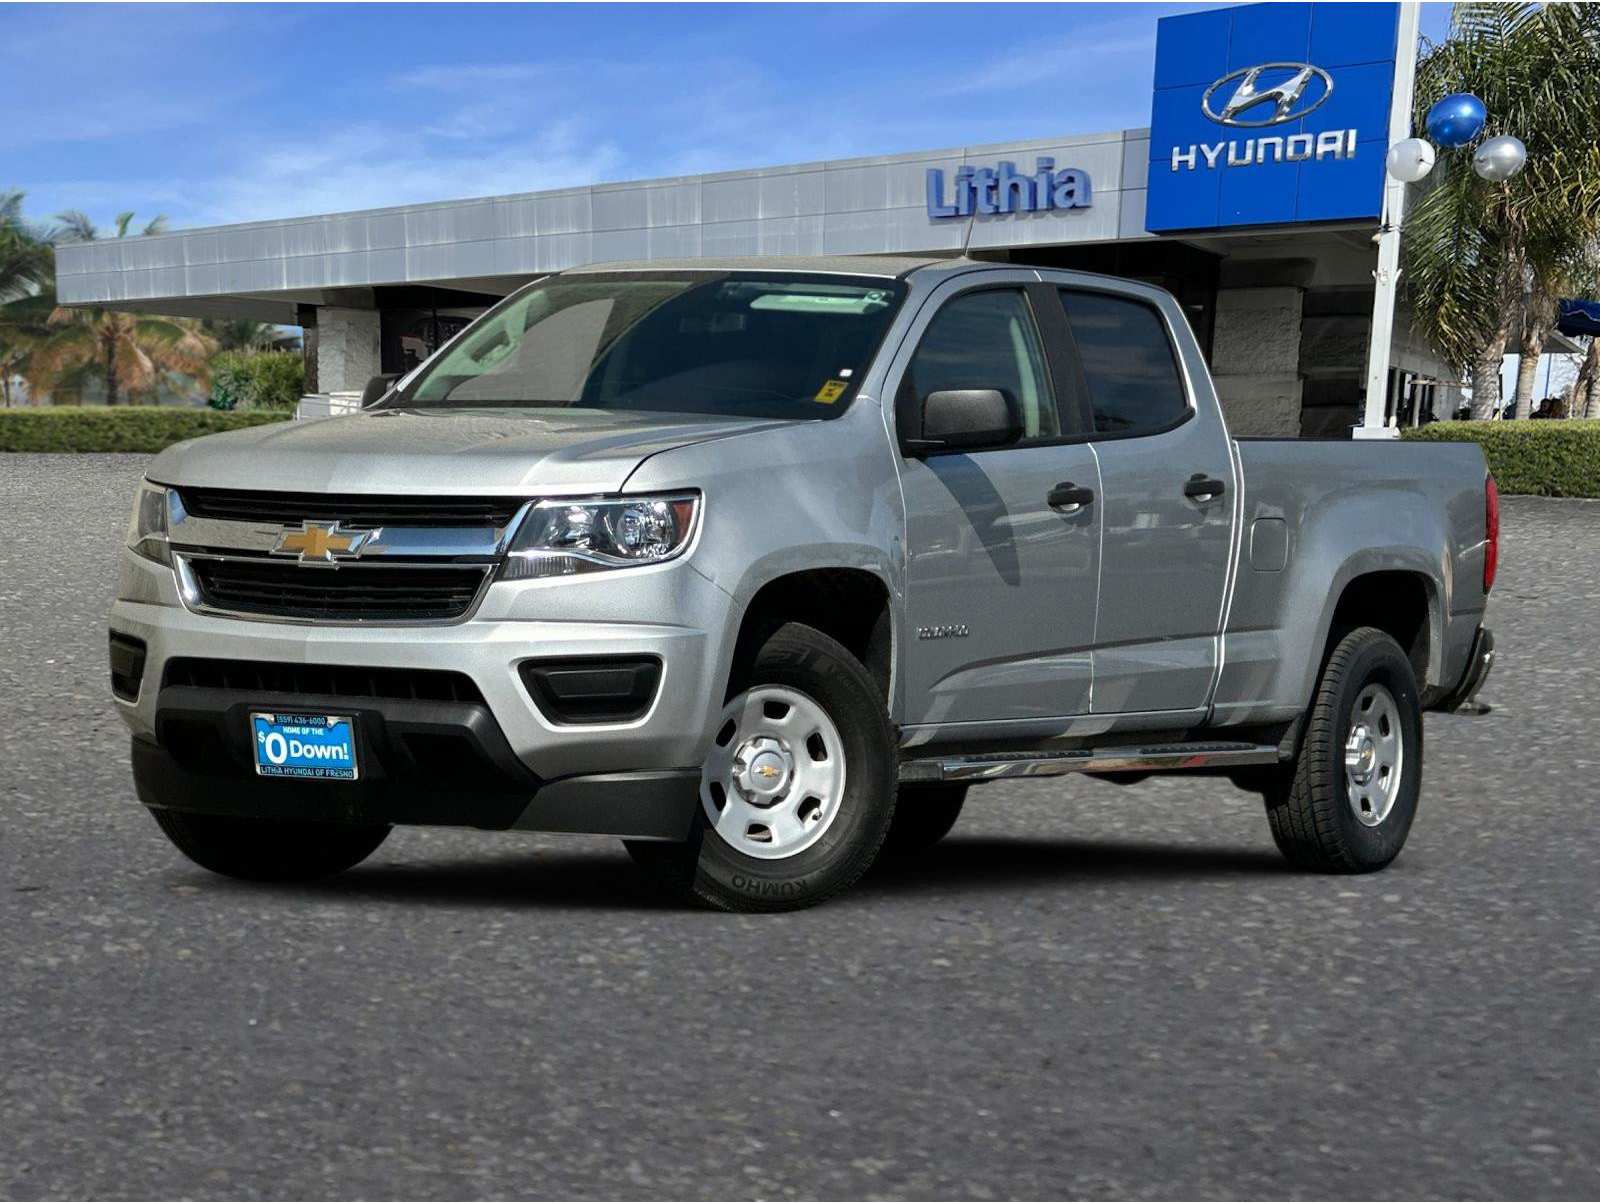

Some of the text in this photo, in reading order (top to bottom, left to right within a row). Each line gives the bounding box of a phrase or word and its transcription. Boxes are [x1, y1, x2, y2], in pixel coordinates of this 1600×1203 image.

[1171, 129, 1357, 171] HYUNDAI
[926, 156, 1092, 218] Lithia
[283, 726, 324, 736] HOME OF THE
[289, 740, 349, 760] Down!
[260, 766, 353, 778] LITHIA HYUNDAI OF FRESNO
[731, 874, 808, 896] KUMHO
